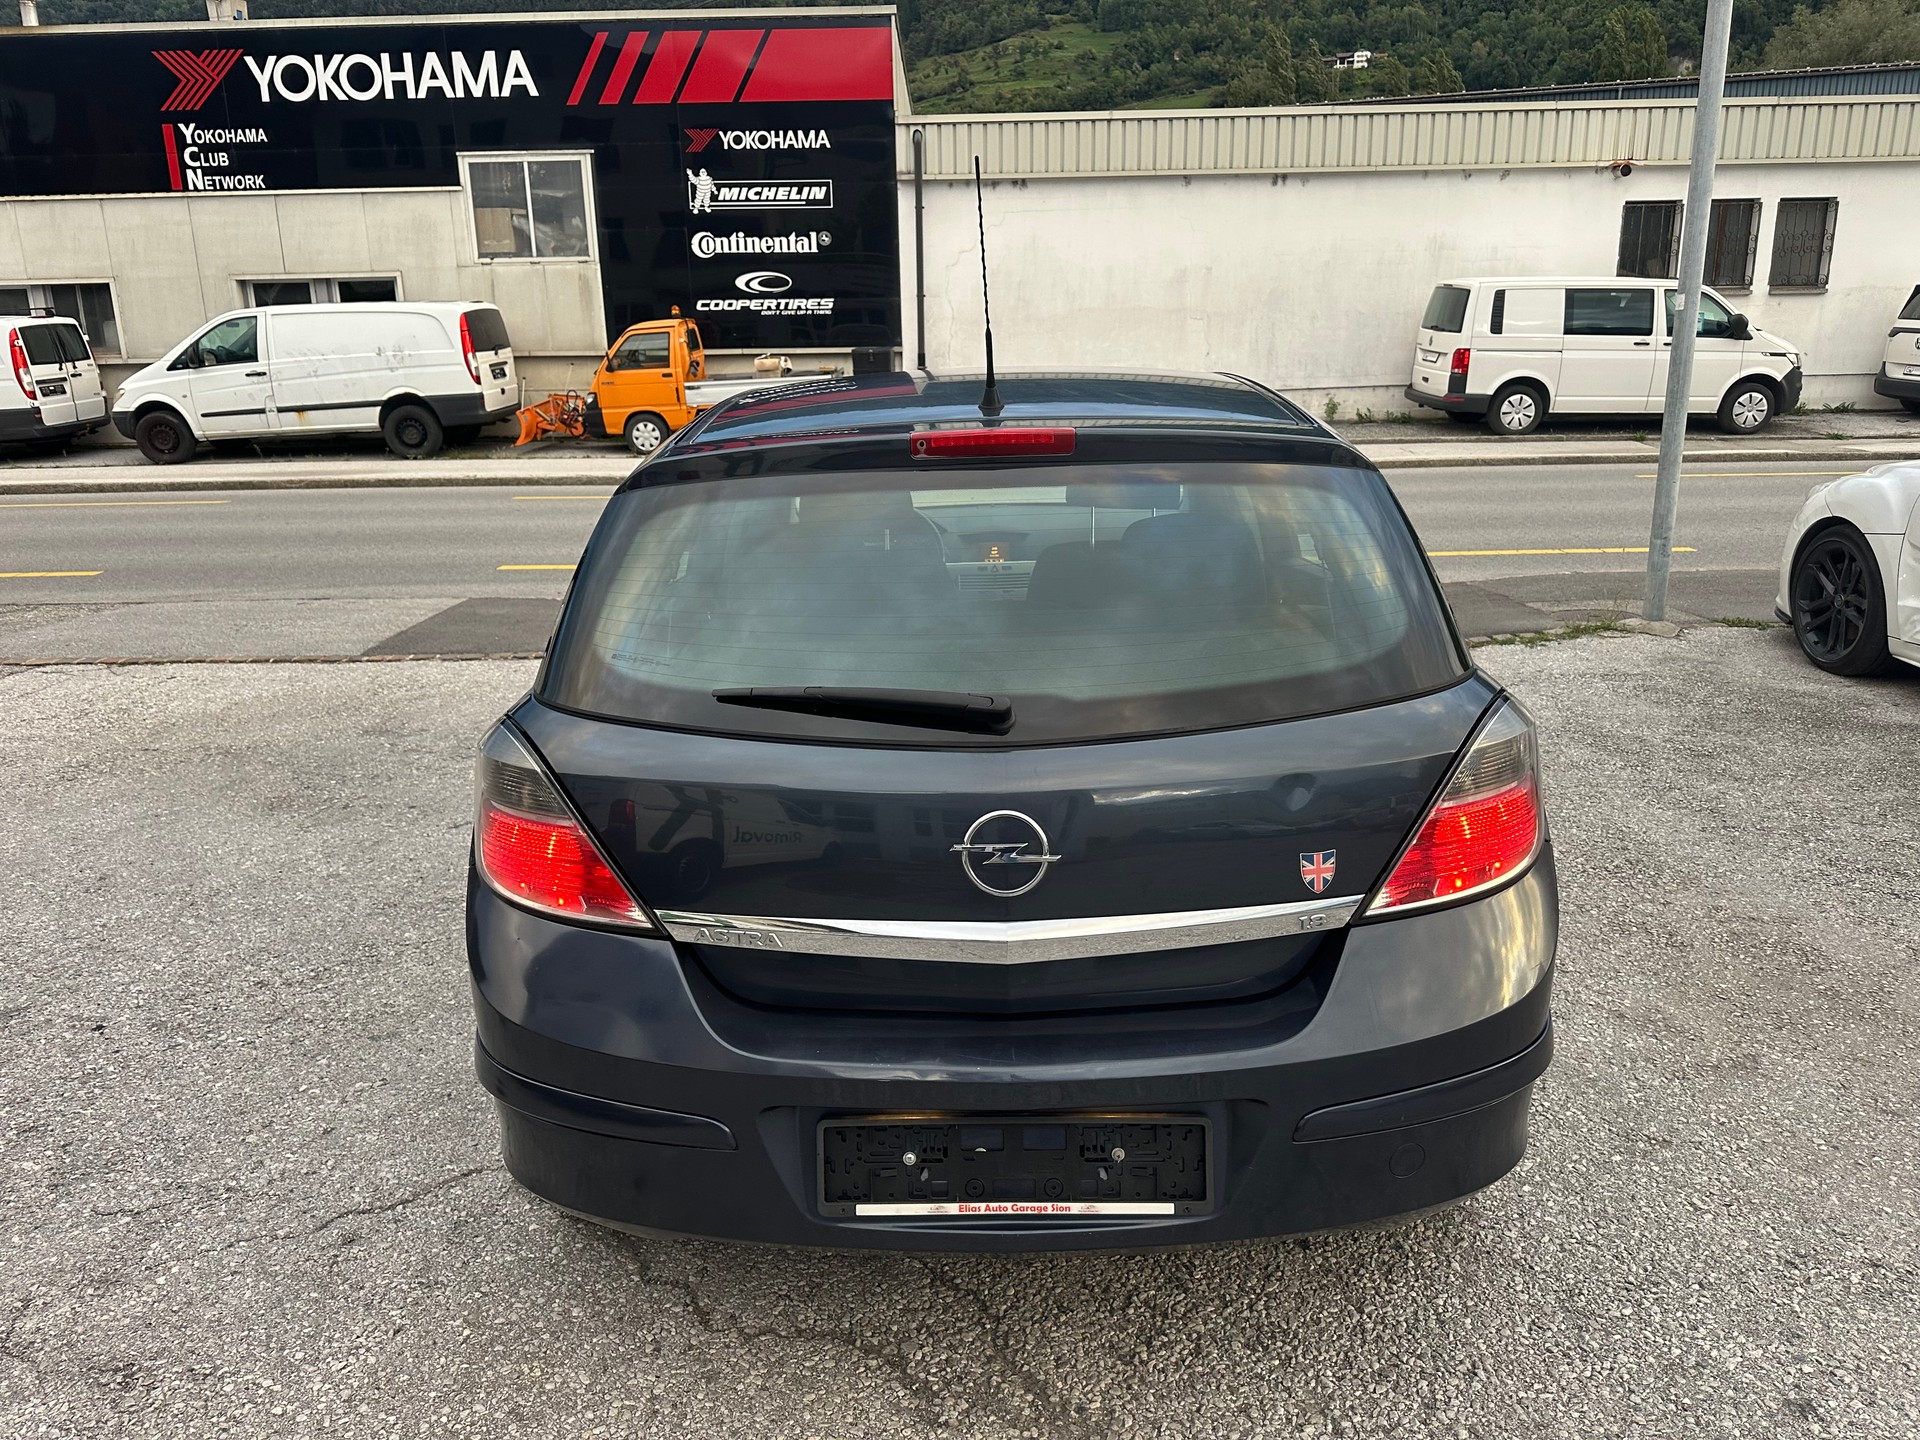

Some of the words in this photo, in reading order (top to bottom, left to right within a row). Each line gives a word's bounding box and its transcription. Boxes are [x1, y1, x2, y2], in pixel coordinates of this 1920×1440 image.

[243, 50, 538, 102] YOKOHAMA
[718, 129, 831, 149] YOKOHAMA
[718, 186, 827, 201] MICHELIN
[691, 231, 818, 258] Continental
[694, 927, 783, 948] ASTRA
[958, 1203, 981, 1213] Elias
[984, 1203, 1008, 1213] Auto
[1011, 1203, 1048, 1214] Garage
[1051, 1203, 1071, 1213] Sion
